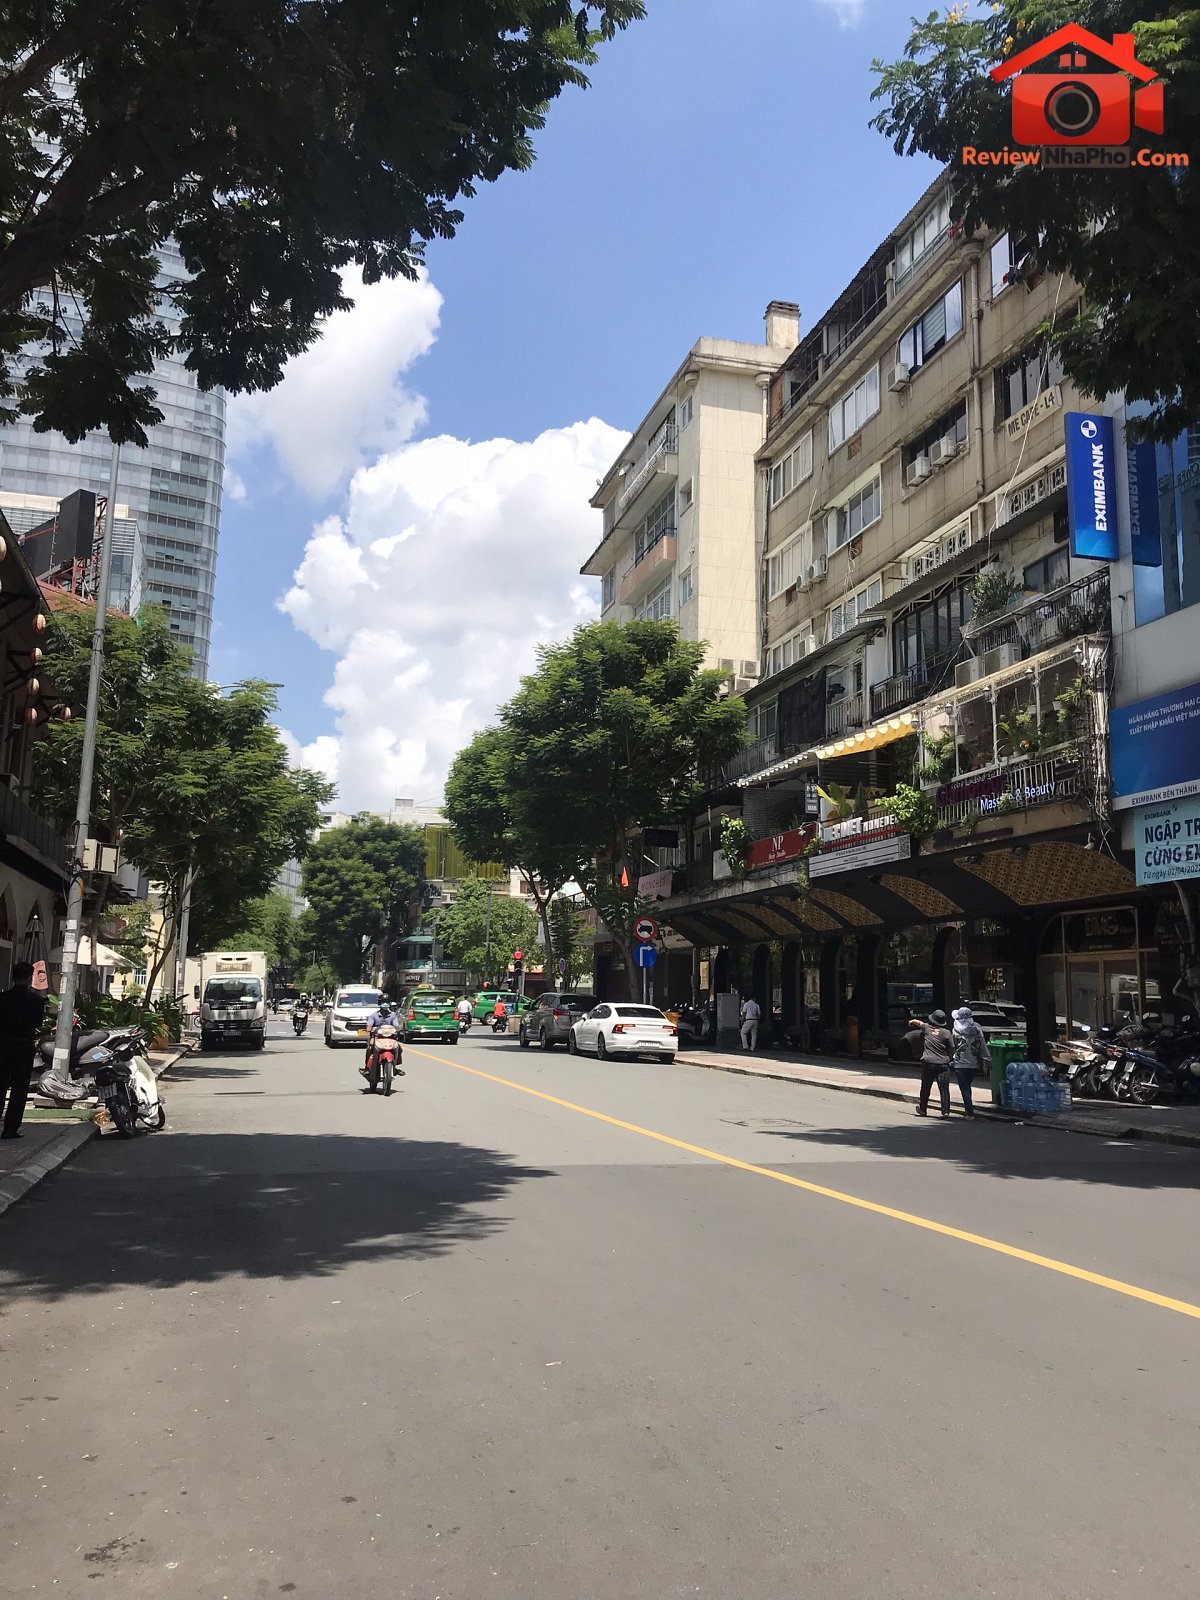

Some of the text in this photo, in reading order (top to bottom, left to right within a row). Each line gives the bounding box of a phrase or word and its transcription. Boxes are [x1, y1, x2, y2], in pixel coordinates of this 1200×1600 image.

[1091, 443, 1107, 532] EXIMBANK
[1184, 698, 1195, 708] MẠI
[980, 781, 1056, 812] Masse & Beauty
[1131, 792, 1162, 805] EXIMBANK
[1175, 784, 1198, 796] THÀNH
[1144, 809, 1172, 820] EXIMBANK
[772, 835, 784, 851] NP
[1144, 819, 1181, 846] NGẬP
[1144, 845, 1182, 867] CÙNG
